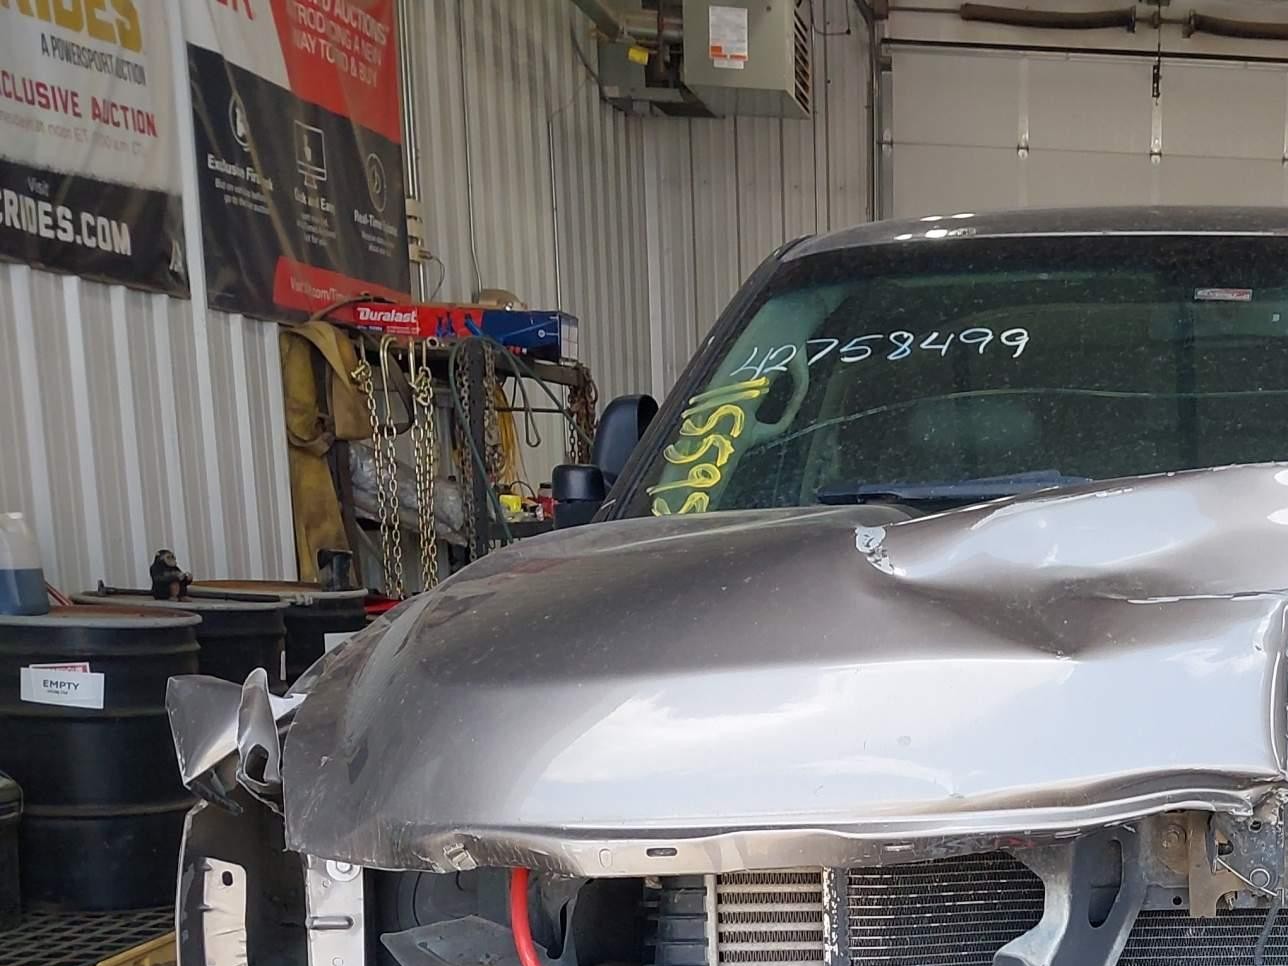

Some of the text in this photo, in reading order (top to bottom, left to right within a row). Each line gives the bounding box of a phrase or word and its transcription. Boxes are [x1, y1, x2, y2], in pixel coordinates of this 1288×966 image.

[41, 33, 50, 57] A
[51, 36, 114, 75] POWERSPORT
[0, 70, 82, 118] CLUSIVE
[91, 96, 158, 138] AUCTION
[0, 188, 131, 256] RIDES.COM
[357, 307, 417, 323] Duralast
[730, 327, 1030, 380] 42758499
[42, 679, 80, 691] EMPTY
